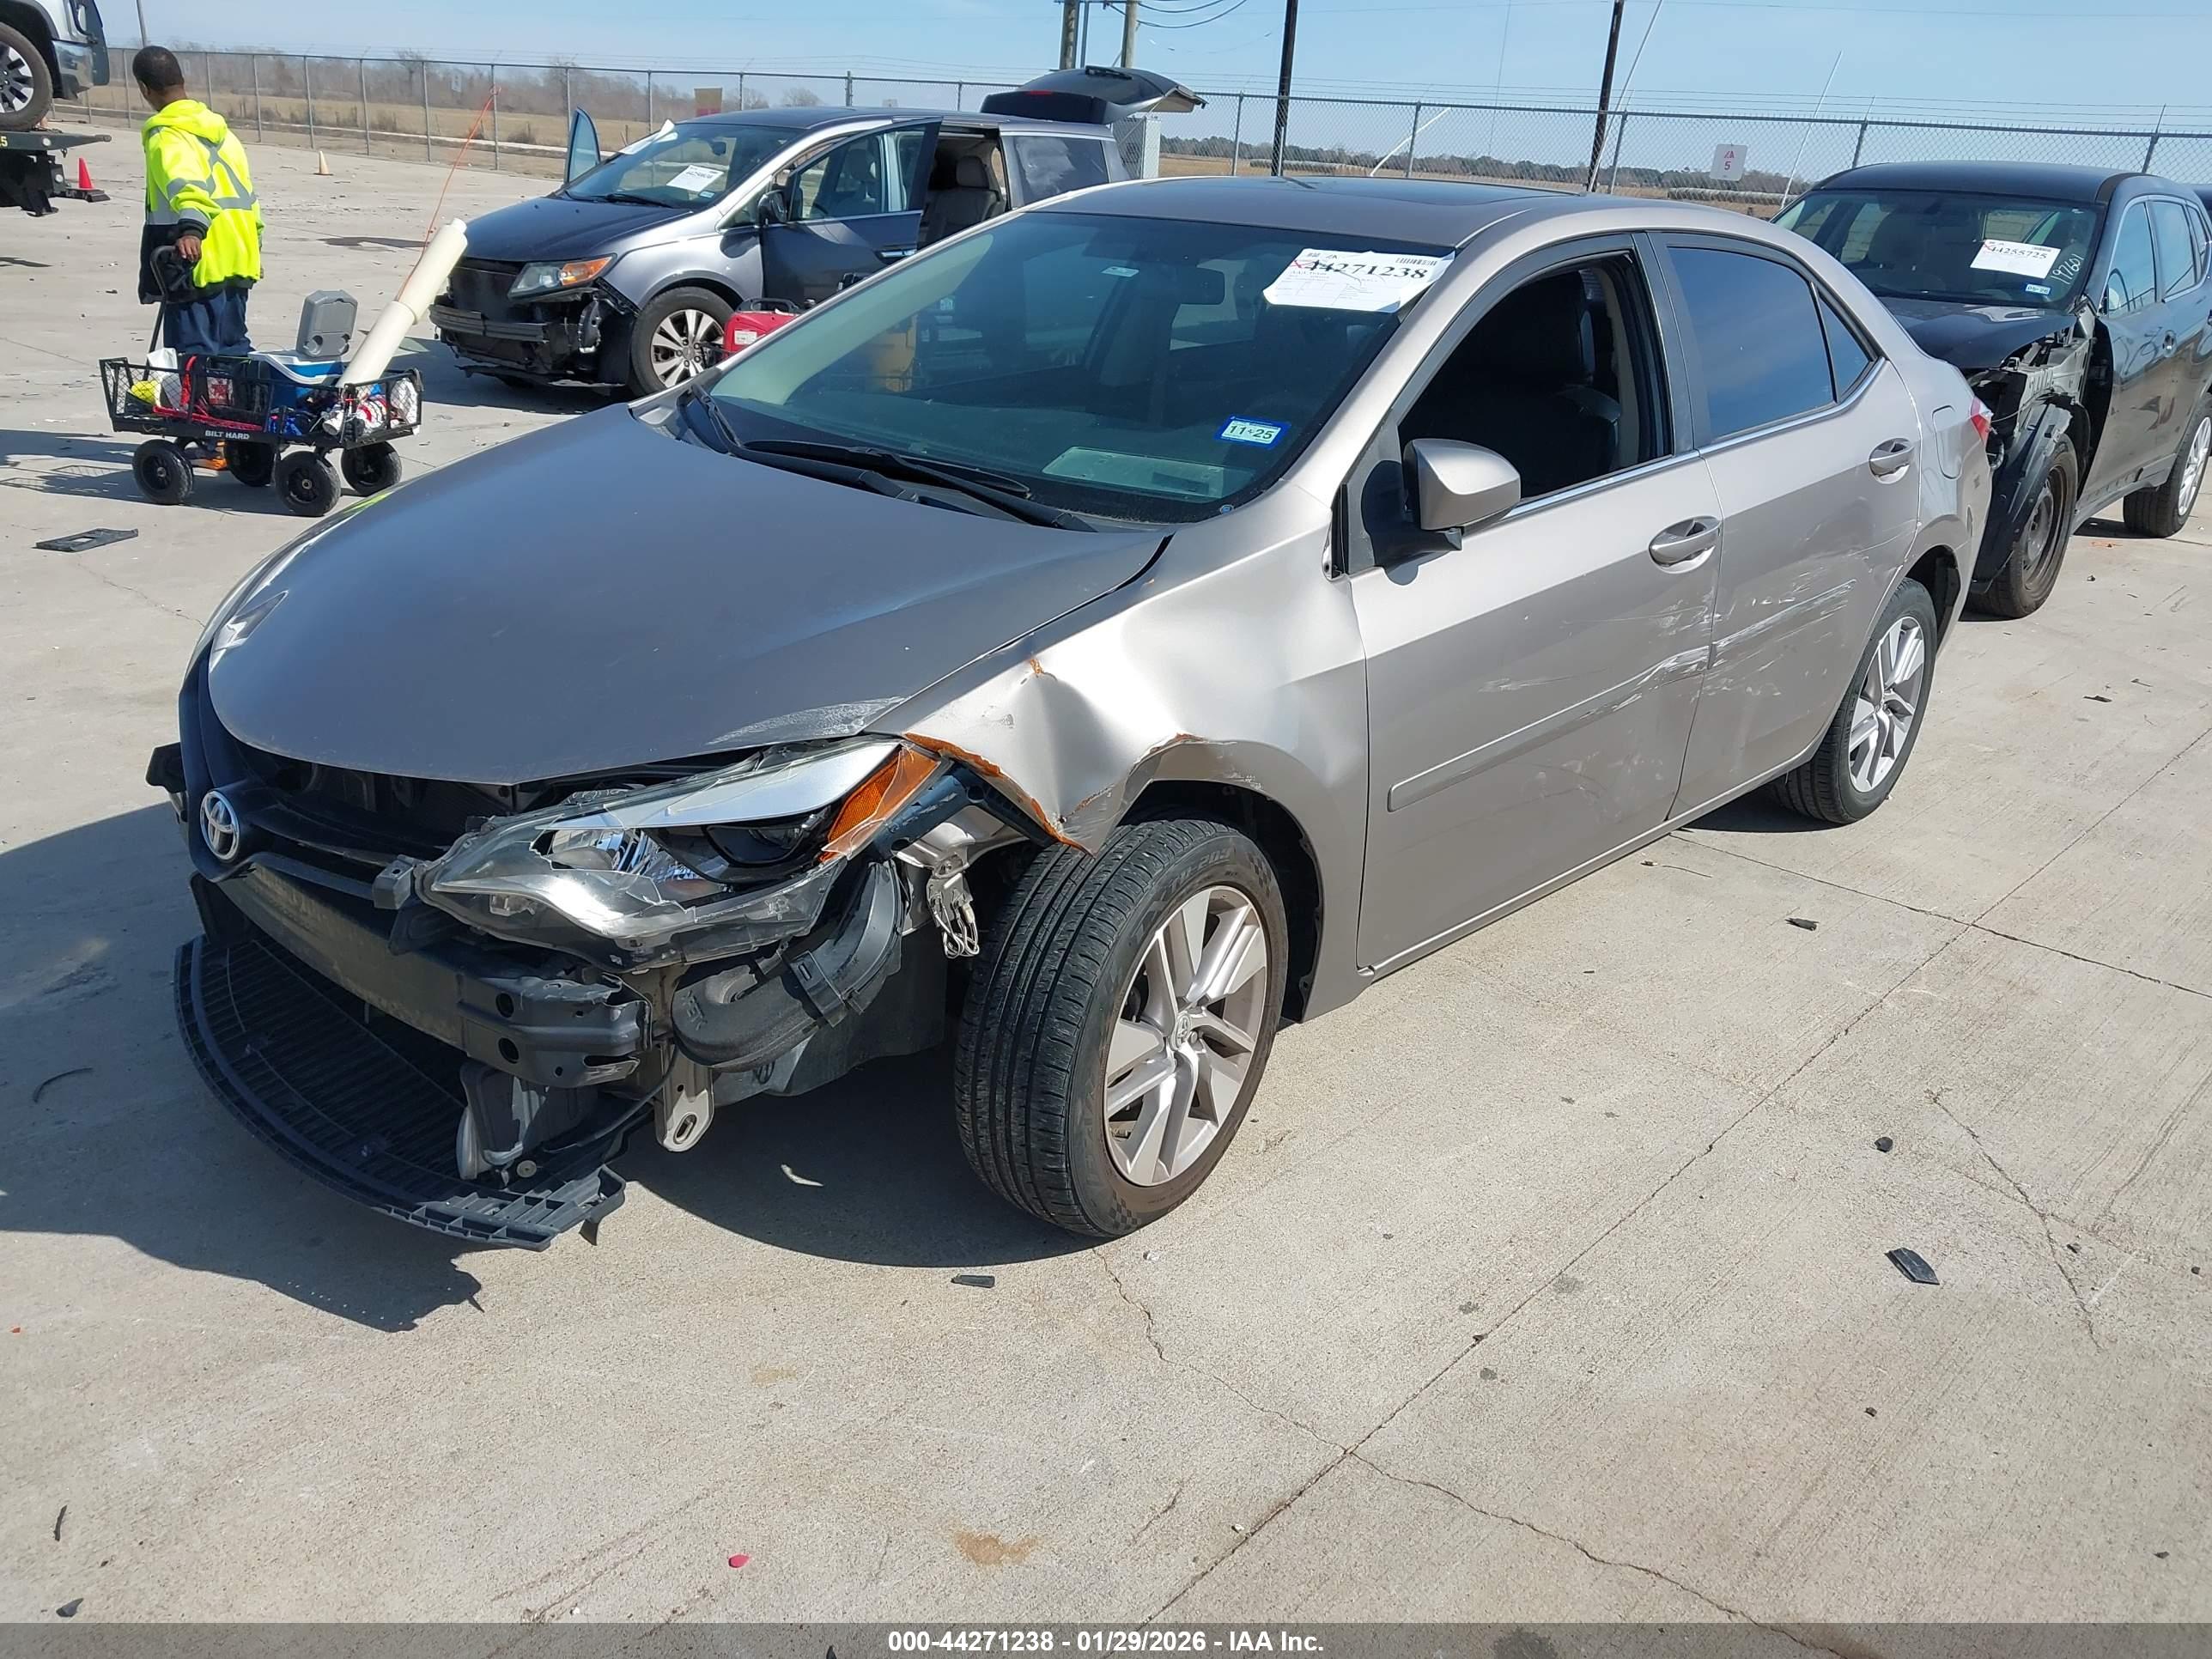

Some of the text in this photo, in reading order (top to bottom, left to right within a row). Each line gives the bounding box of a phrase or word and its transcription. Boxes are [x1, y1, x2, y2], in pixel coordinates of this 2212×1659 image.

[1724, 161, 1731, 171] 5
[1990, 246, 2048, 259] 44255725
[1304, 259, 1428, 279] 44271238
